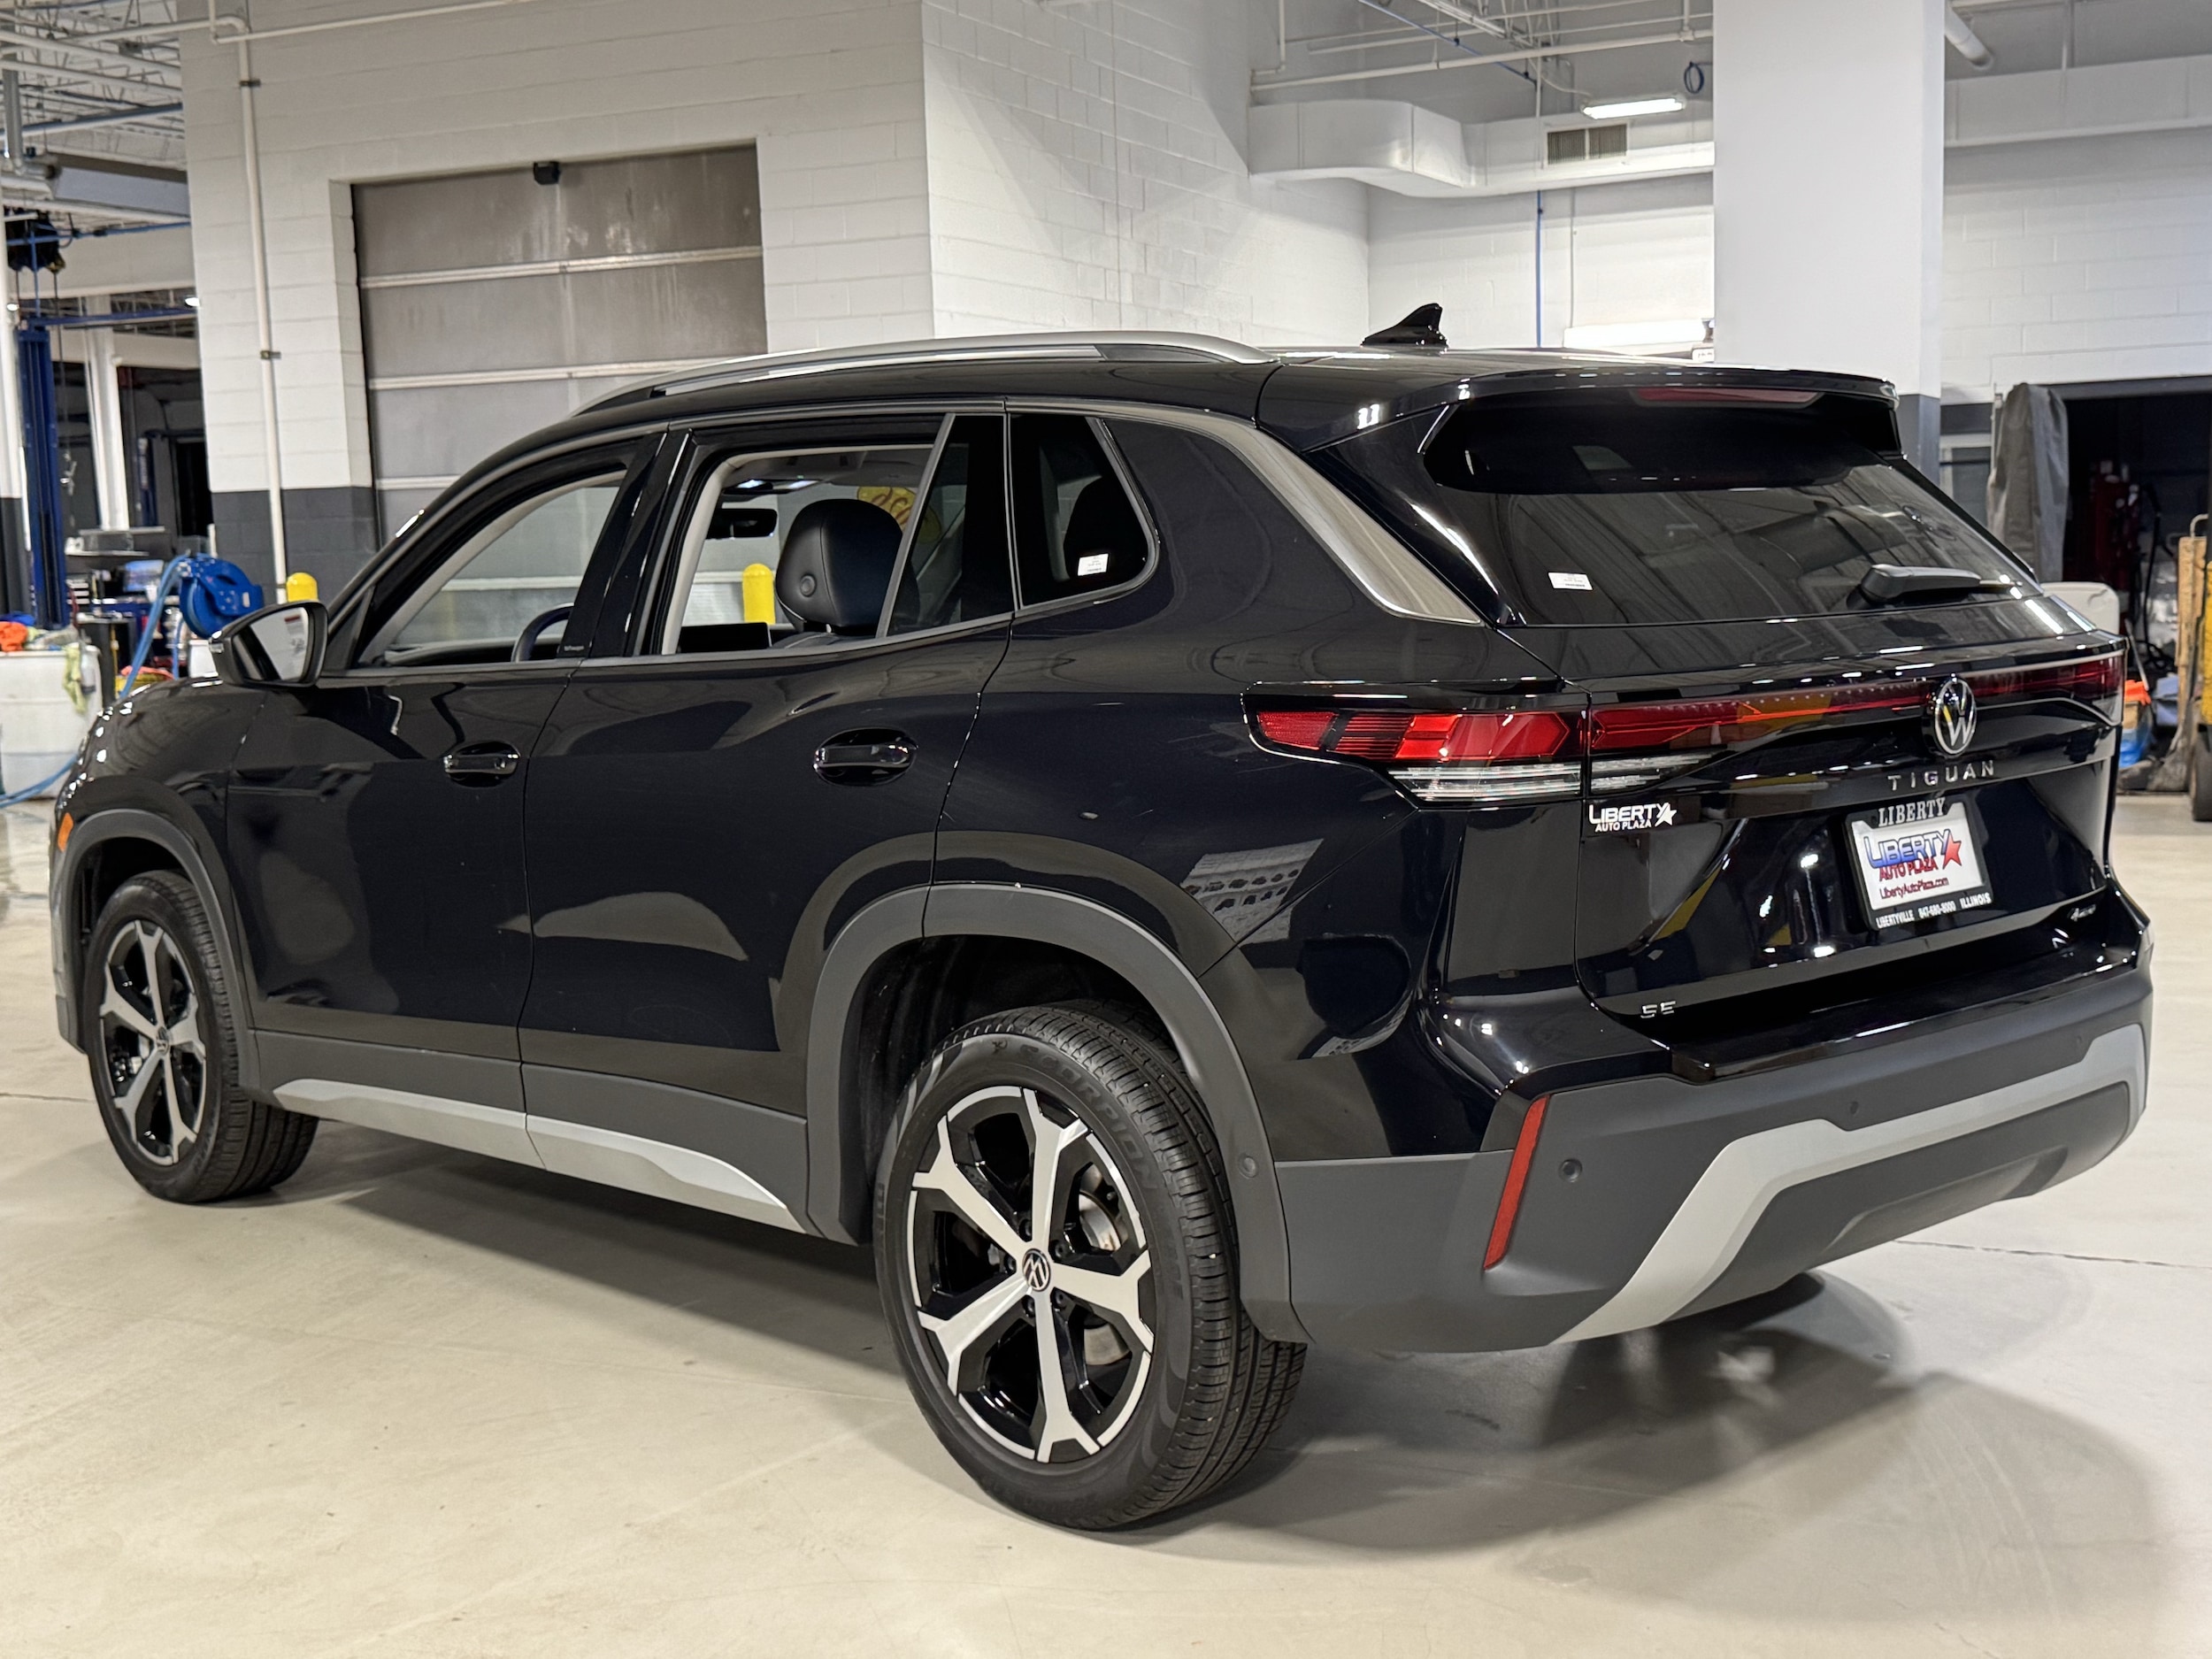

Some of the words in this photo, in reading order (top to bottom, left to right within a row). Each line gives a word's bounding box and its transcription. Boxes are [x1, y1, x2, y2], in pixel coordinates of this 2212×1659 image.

[1887, 759, 1995, 791] TIGUAN
[1588, 802, 1670, 825] LIBERTY
[1878, 797, 1947, 827] LIBERTY
[1594, 821, 1621, 833] AUTO
[1621, 818, 1652, 830] PLAZA
[1863, 828, 1951, 869] LIBERTY
[1879, 862, 1907, 882] AUTO
[1907, 856, 1939, 876] PLAZA
[1879, 877, 1949, 899] LibertyAutoPlaza.com
[1876, 909, 1915, 929] LIBERTYVILLE
[1959, 892, 1992, 910] ILLINOIS
[1640, 1000, 1676, 1019] SE
